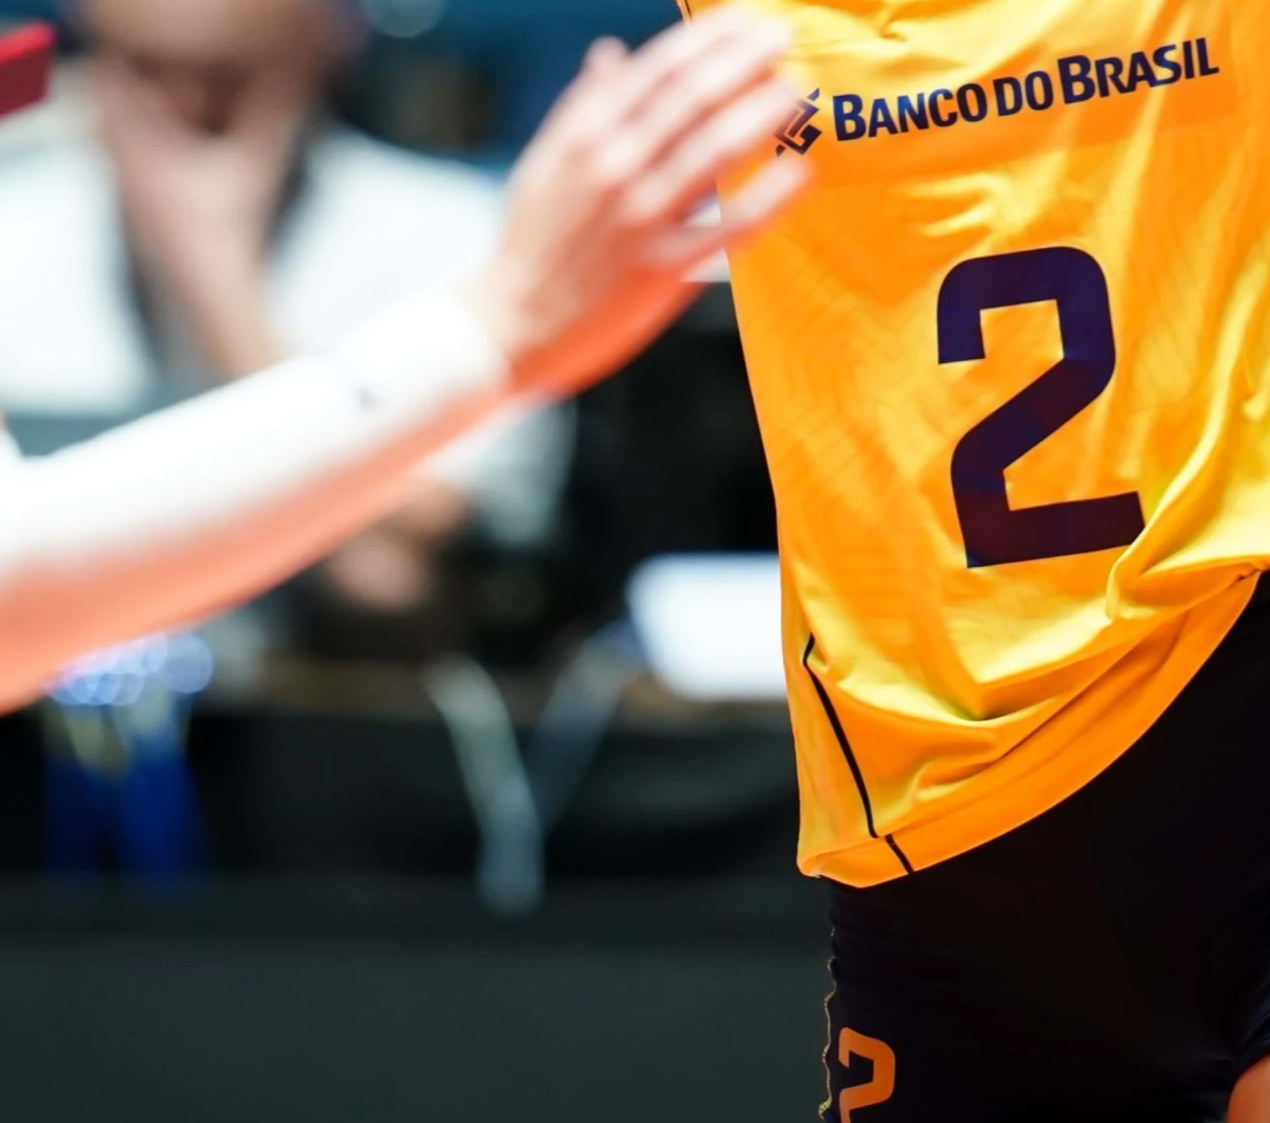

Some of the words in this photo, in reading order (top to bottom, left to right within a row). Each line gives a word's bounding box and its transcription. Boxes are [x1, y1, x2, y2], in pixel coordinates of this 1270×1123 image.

[832, 81, 988, 141] BANCO
[993, 70, 1054, 117] DO
[1057, 37, 1220, 105] BRASIL
[936, 245, 1146, 569] 2
